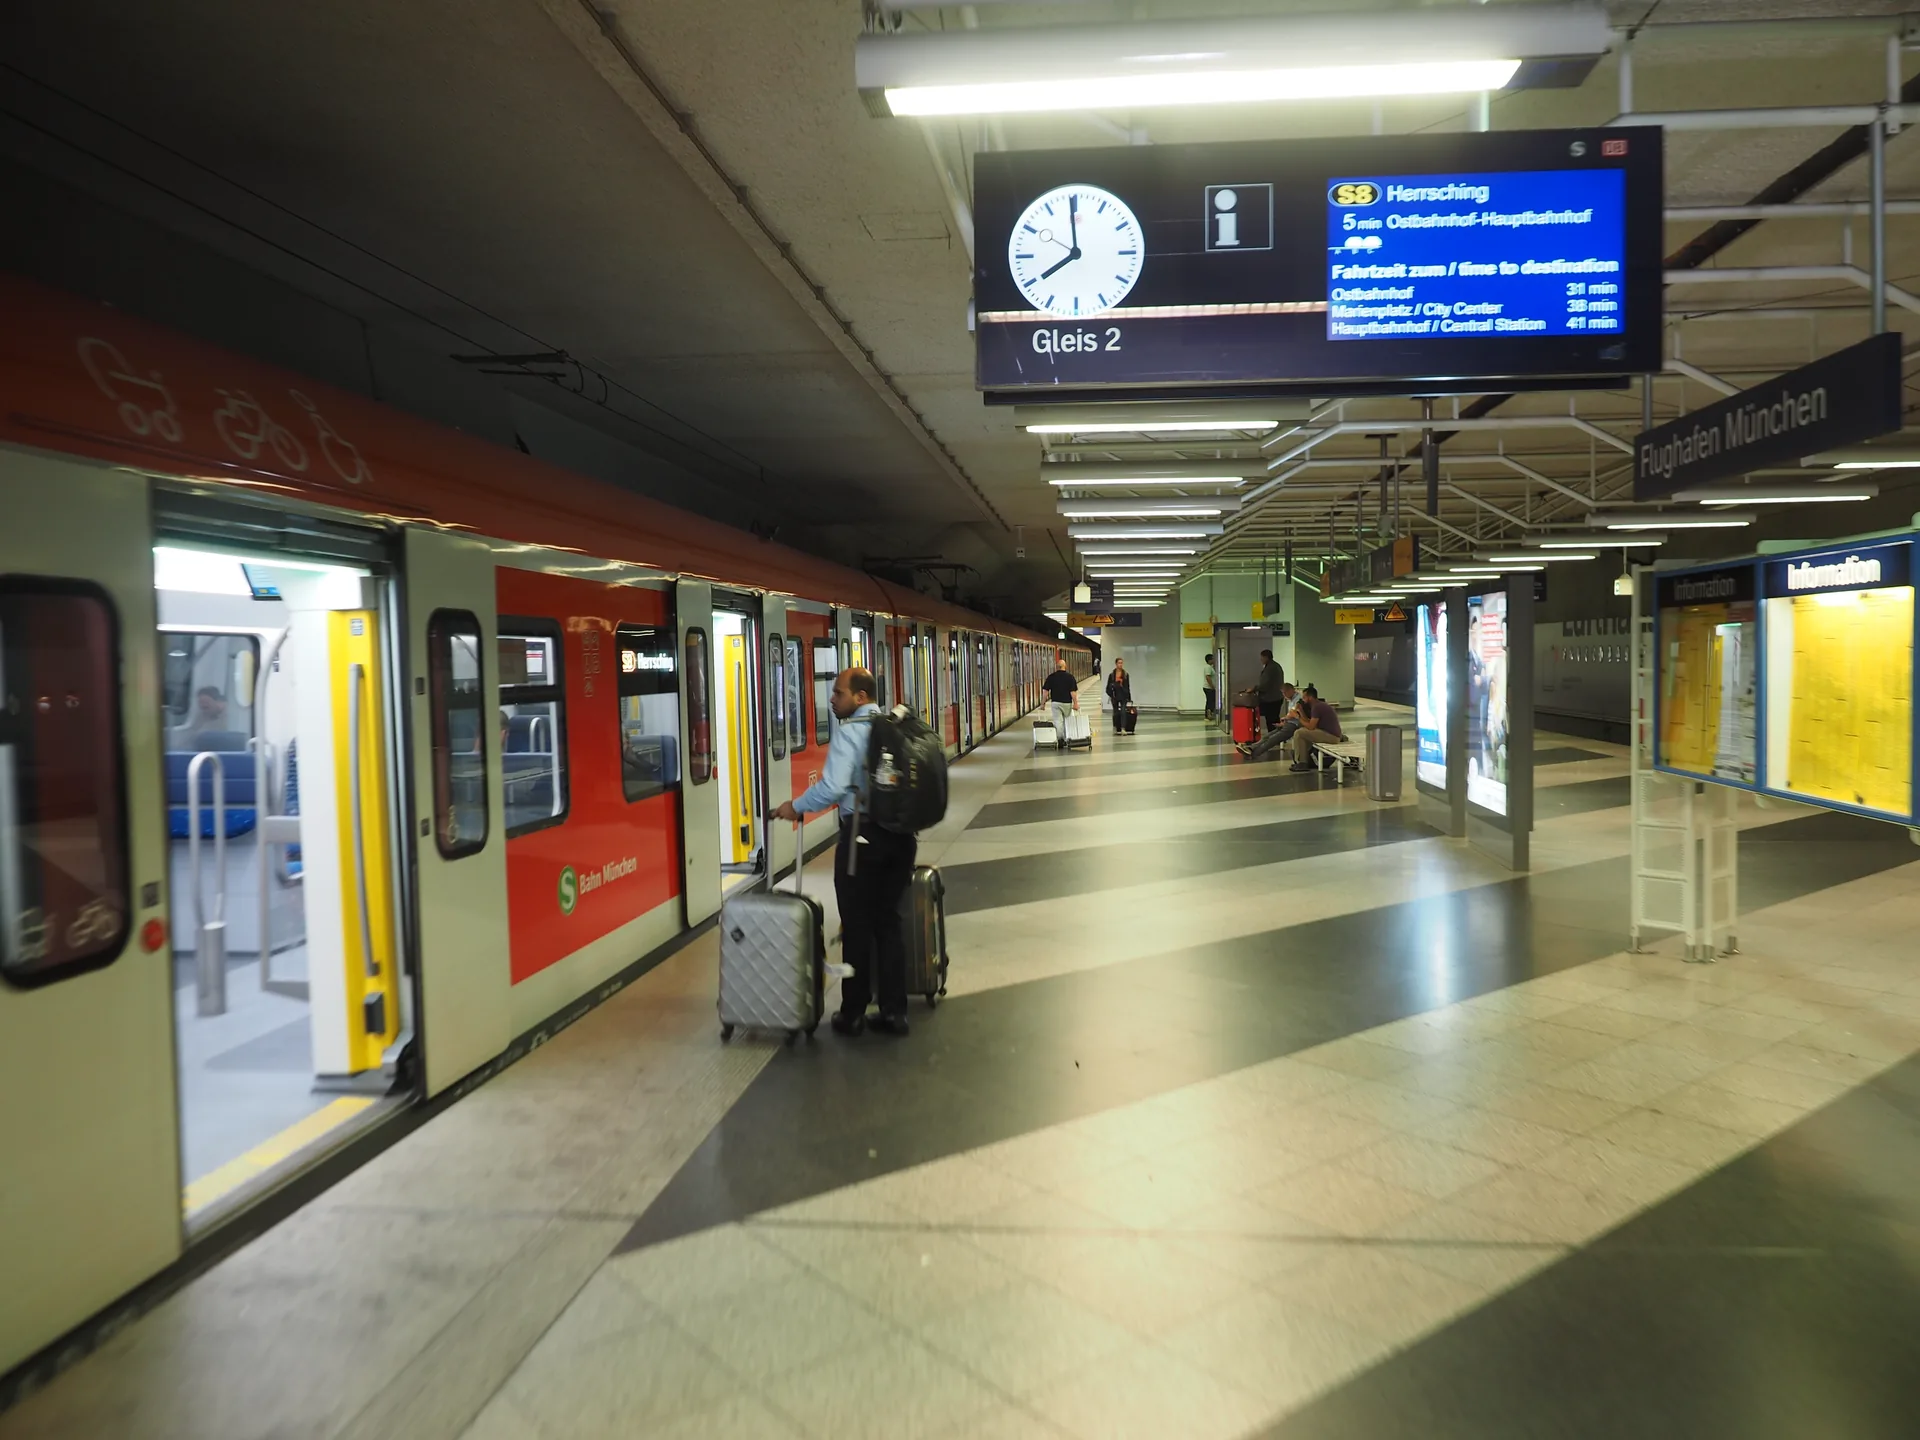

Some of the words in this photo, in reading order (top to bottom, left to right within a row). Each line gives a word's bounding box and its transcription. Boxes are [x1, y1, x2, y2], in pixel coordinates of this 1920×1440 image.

[1337, 184, 1373, 204] S8
[1386, 183, 1489, 204] Herrsching
[1343, 213, 1356, 231] 5
[1357, 217, 1383, 230] min
[1331, 263, 1407, 280] Fahrtzeit
[1408, 264, 1447, 278] zum
[1448, 261, 1457, 277] /
[1458, 261, 1498, 277] time
[1499, 261, 1519, 275] to
[1520, 257, 1620, 275] destination
[1331, 286, 1415, 301] Ostbahnhof
[1566, 282, 1586, 296] 31
[1588, 281, 1618, 295] min
[1332, 303, 1414, 320] Marienplatz
[1422, 302, 1453, 318] City
[1453, 301, 1504, 315] Center
[1566, 299, 1588, 312] 38
[1588, 298, 1618, 312] min
[1332, 319, 1431, 337] Hauptbahnhof
[1440, 318, 1494, 332] Central
[1494, 317, 1547, 331] Station
[1566, 316, 1587, 329] 41
[1588, 315, 1618, 329] min
[1032, 328, 1098, 353] Gleis
[1104, 327, 1121, 351] 2
[1640, 424, 1721, 479] Flughafen
[1725, 386, 1828, 450] München
[1787, 555, 1882, 590] Information
[1674, 573, 1737, 601] Information
[637, 652, 674, 672] Herrsching
[560, 868, 577, 913] S
[579, 870, 602, 895] Bahn
[602, 857, 637, 885] München
